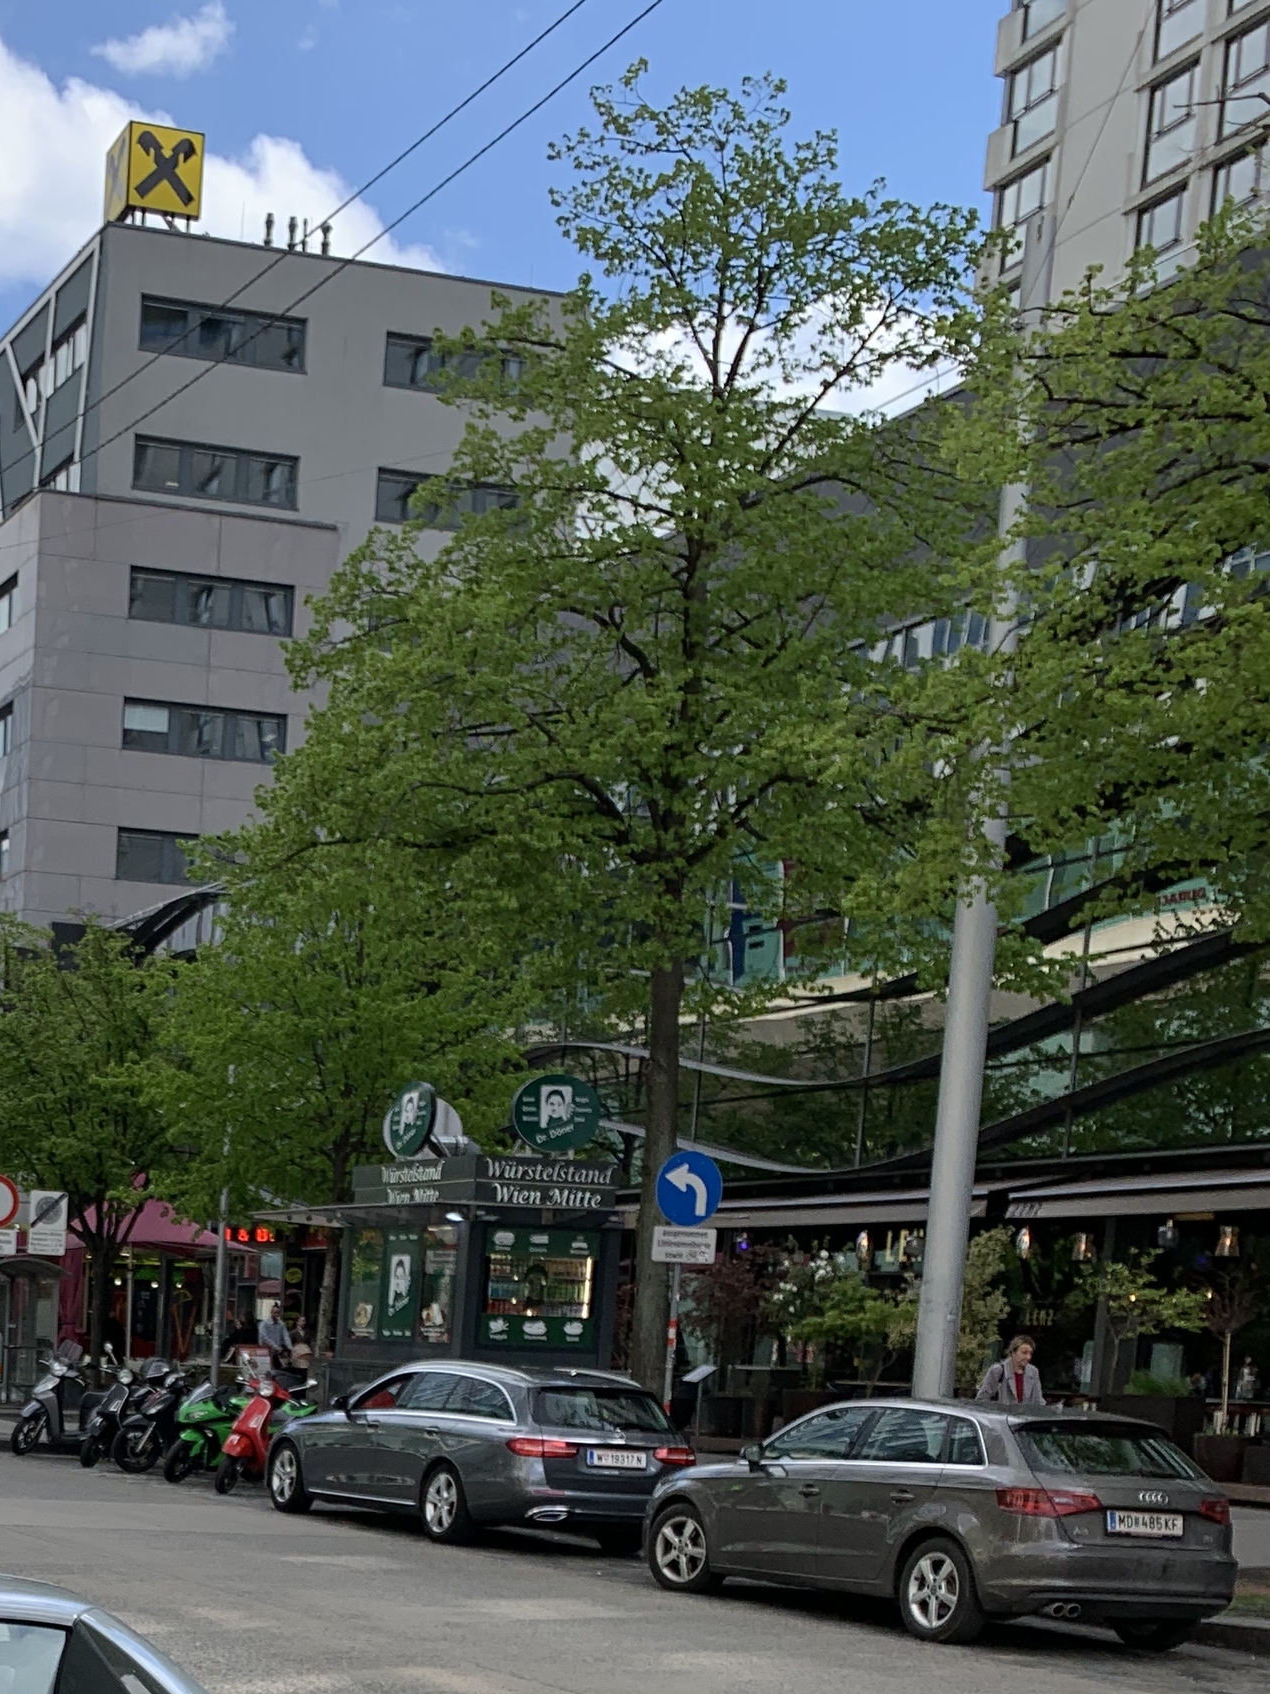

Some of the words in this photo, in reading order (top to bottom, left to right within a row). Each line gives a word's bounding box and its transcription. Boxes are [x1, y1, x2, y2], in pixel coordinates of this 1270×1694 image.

[535, 1133, 550, 1144] Dr.
[549, 1123, 574, 1139] Döner
[381, 1159, 446, 1184] Würstelstand
[486, 1157, 618, 1184] Würstelstand
[492, 1183, 542, 1205] Wien
[546, 1187, 602, 1208] Mitte
[596, 1453, 603, 1464] W
[1118, 1514, 1133, 1528] MD
[1164, 1517, 1178, 1531] KF
